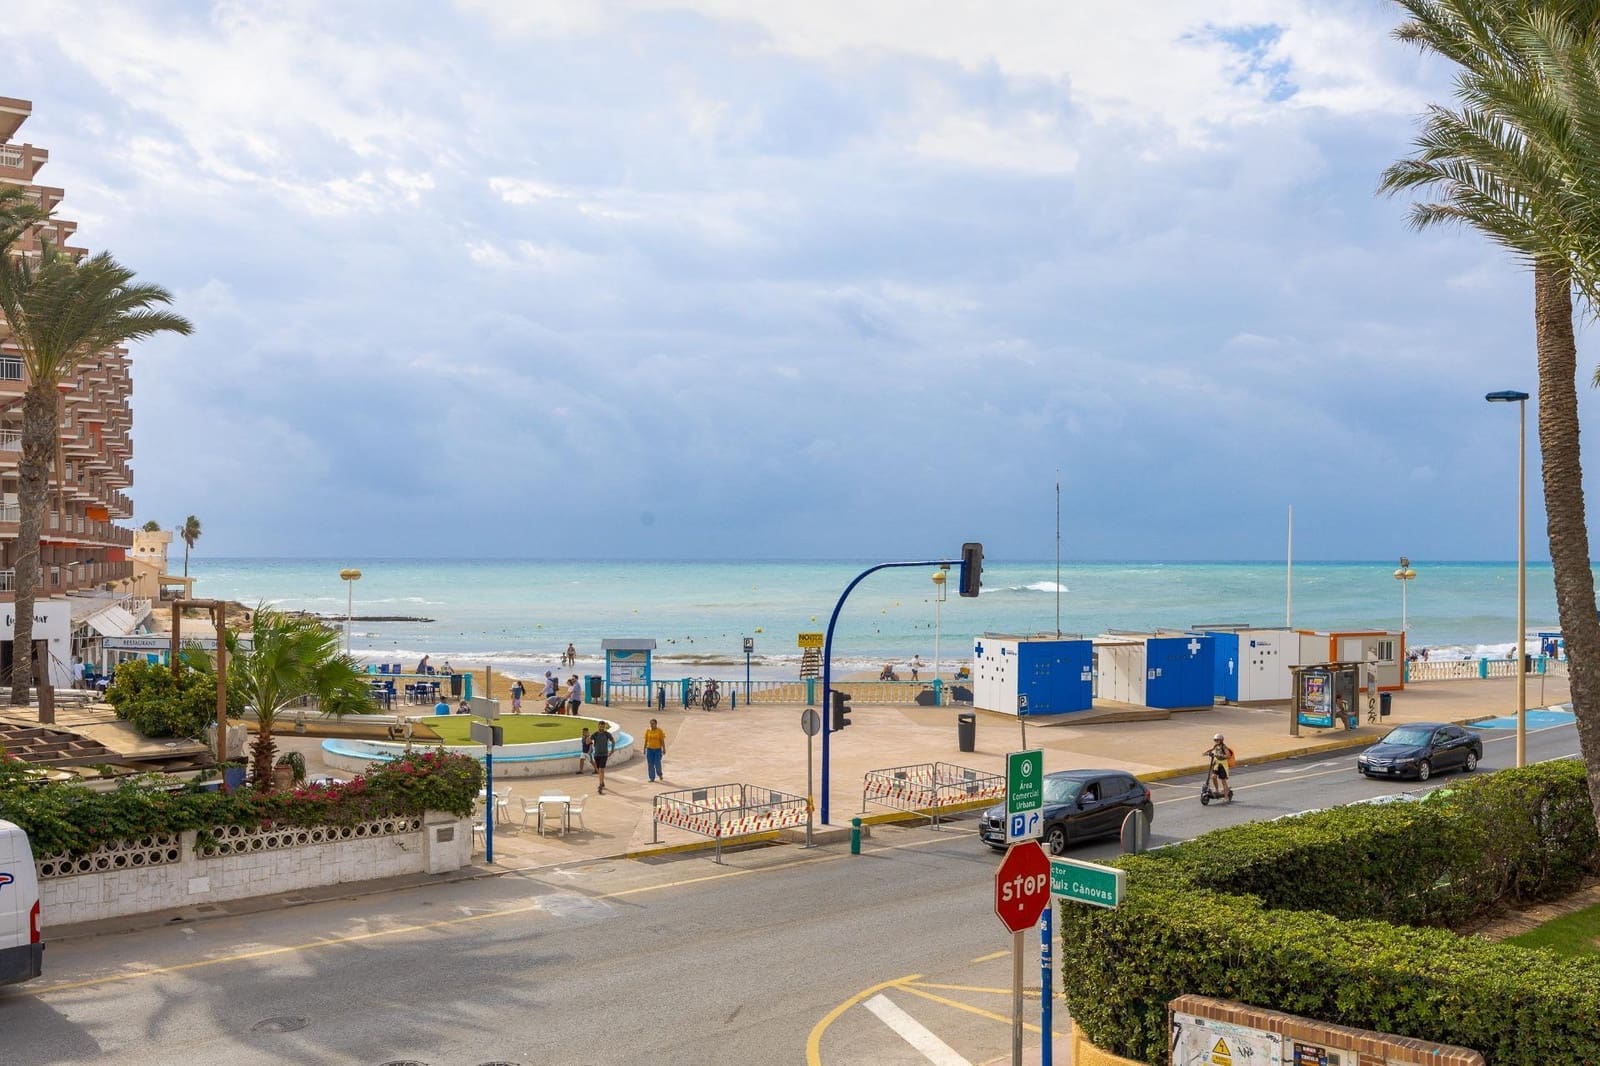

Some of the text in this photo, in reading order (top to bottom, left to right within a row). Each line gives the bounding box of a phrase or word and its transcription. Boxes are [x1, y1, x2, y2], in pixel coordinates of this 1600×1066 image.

[1019, 780, 1033, 790] Área
[1012, 789, 1040, 801] Comercial
[1016, 801, 1036, 810] Urbana
[1014, 817, 1024, 836] P
[1051, 866, 1066, 875] ctor
[1002, 873, 1047, 901] STOP
[1050, 876, 1113, 900] Ruiz Cánovas
